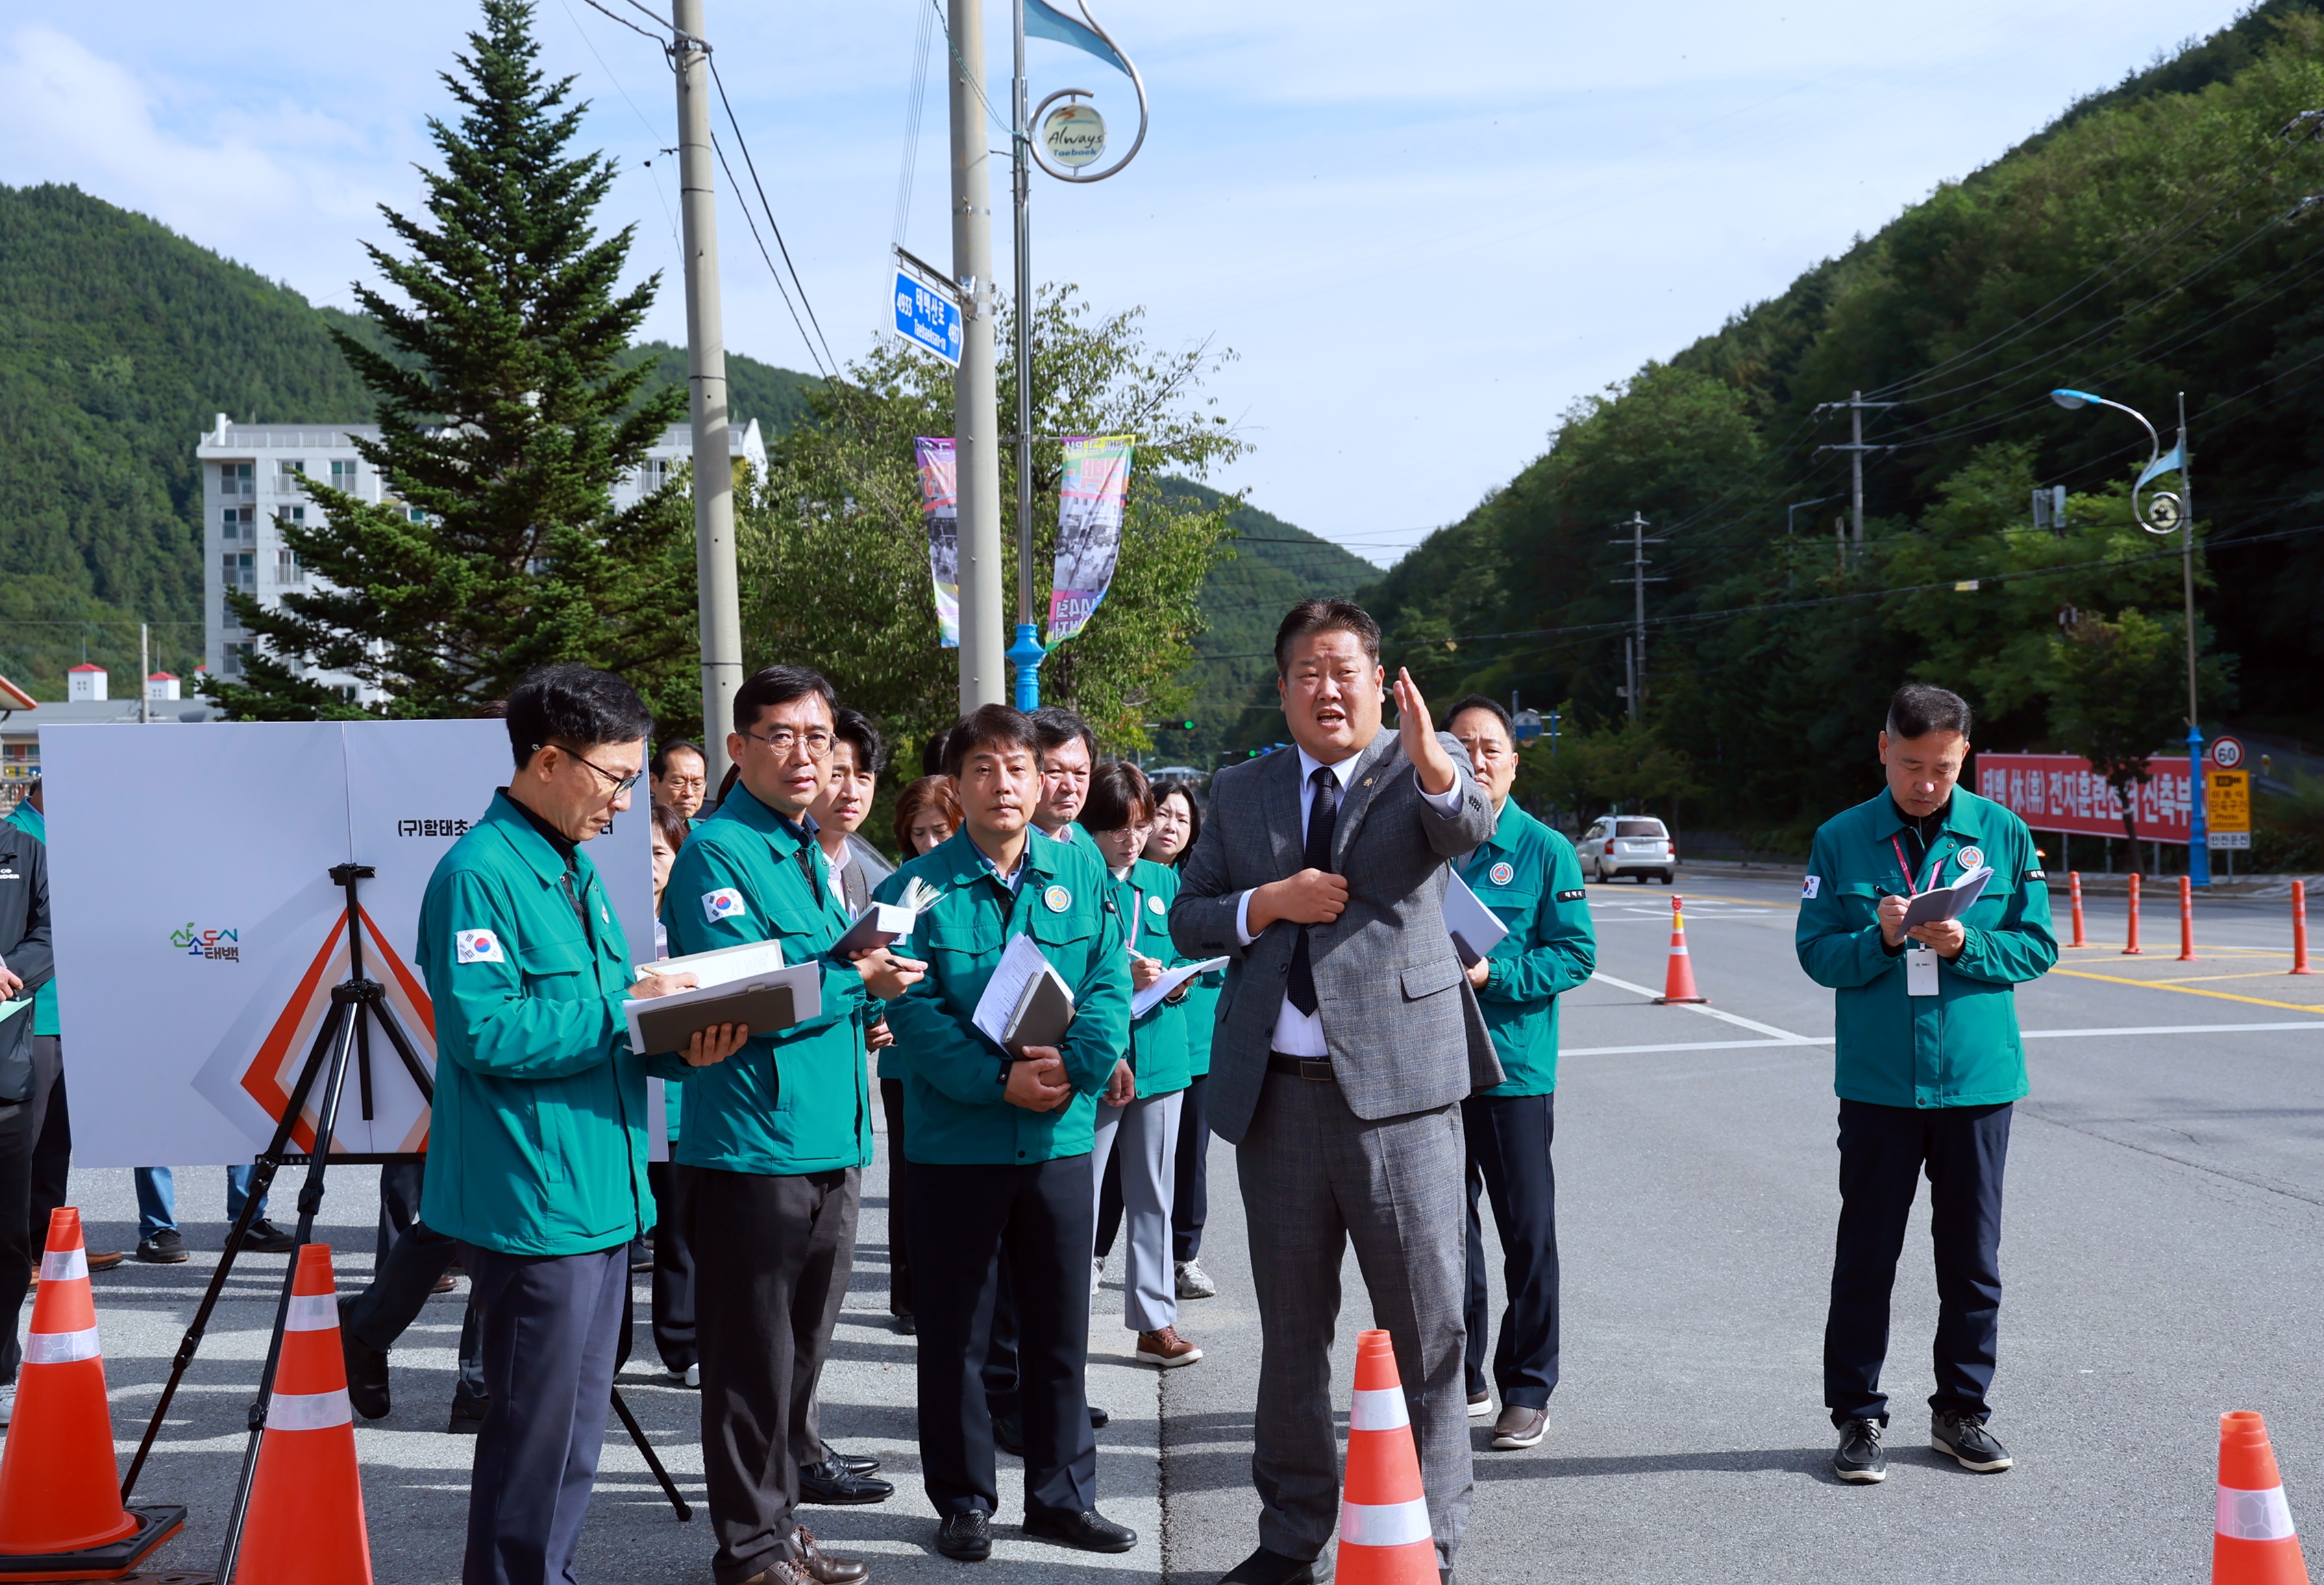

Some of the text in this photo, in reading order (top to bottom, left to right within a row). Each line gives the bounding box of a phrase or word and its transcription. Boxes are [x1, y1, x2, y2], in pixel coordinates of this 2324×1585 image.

[1048, 125, 1103, 148] Always
[1054, 148, 1096, 156] Taebaek
[897, 291, 913, 317] 4933
[916, 287, 945, 325] 태백산로
[2218, 747, 2236, 762] 60
[1982, 768, 2007, 807] 태백
[170, 925, 238, 955] 산소도시
[204, 947, 239, 963] 태백
